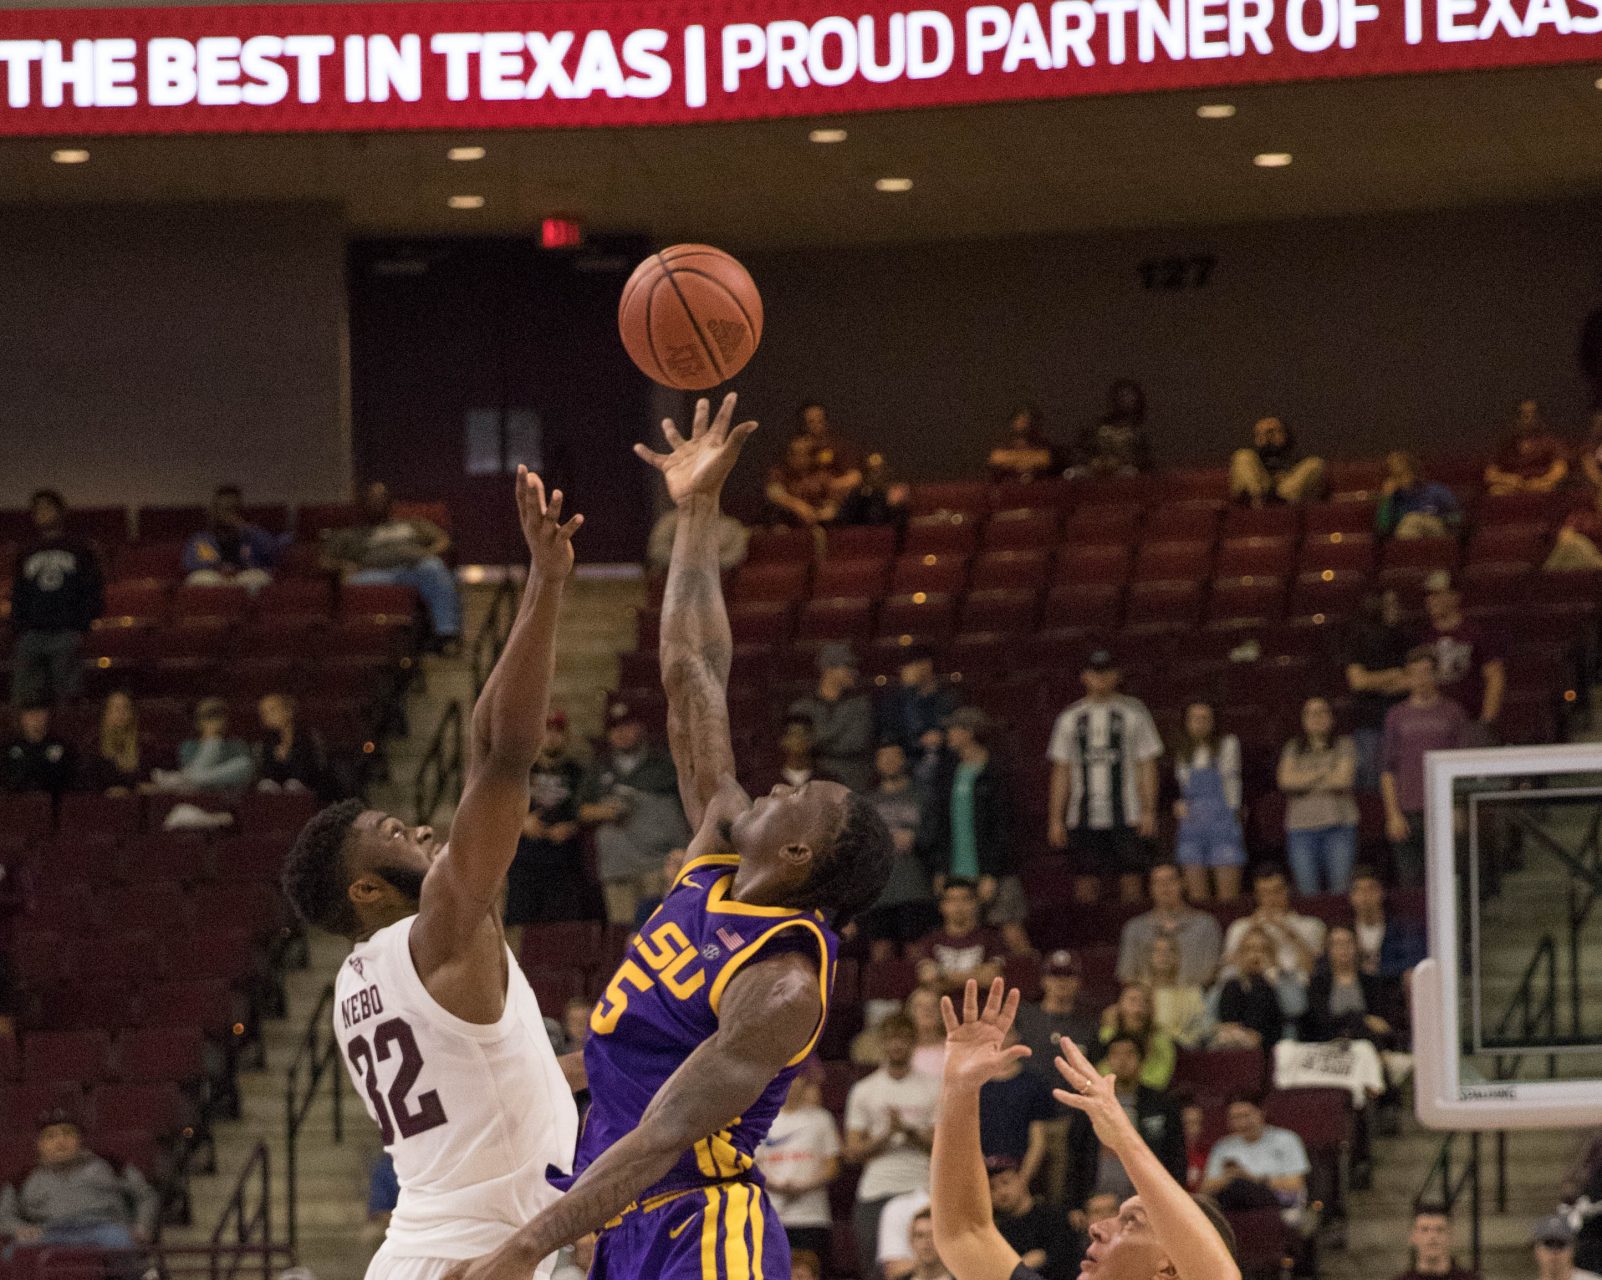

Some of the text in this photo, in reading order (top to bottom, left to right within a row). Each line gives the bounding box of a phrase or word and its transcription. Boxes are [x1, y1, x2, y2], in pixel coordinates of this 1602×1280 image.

[0, 38, 138, 108] THE
[147, 35, 335, 106] BEST
[344, 33, 422, 102] IN
[430, 28, 672, 101] TEXAS
[721, 9, 954, 93] PROUD
[965, 0, 1275, 76] PARTNER
[1285, 0, 1379, 52] OF
[1136, 256, 1216, 290] 127
[341, 983, 384, 1030] NEBO
[590, 958, 656, 1036] 5
[347, 1016, 448, 1147] 32
